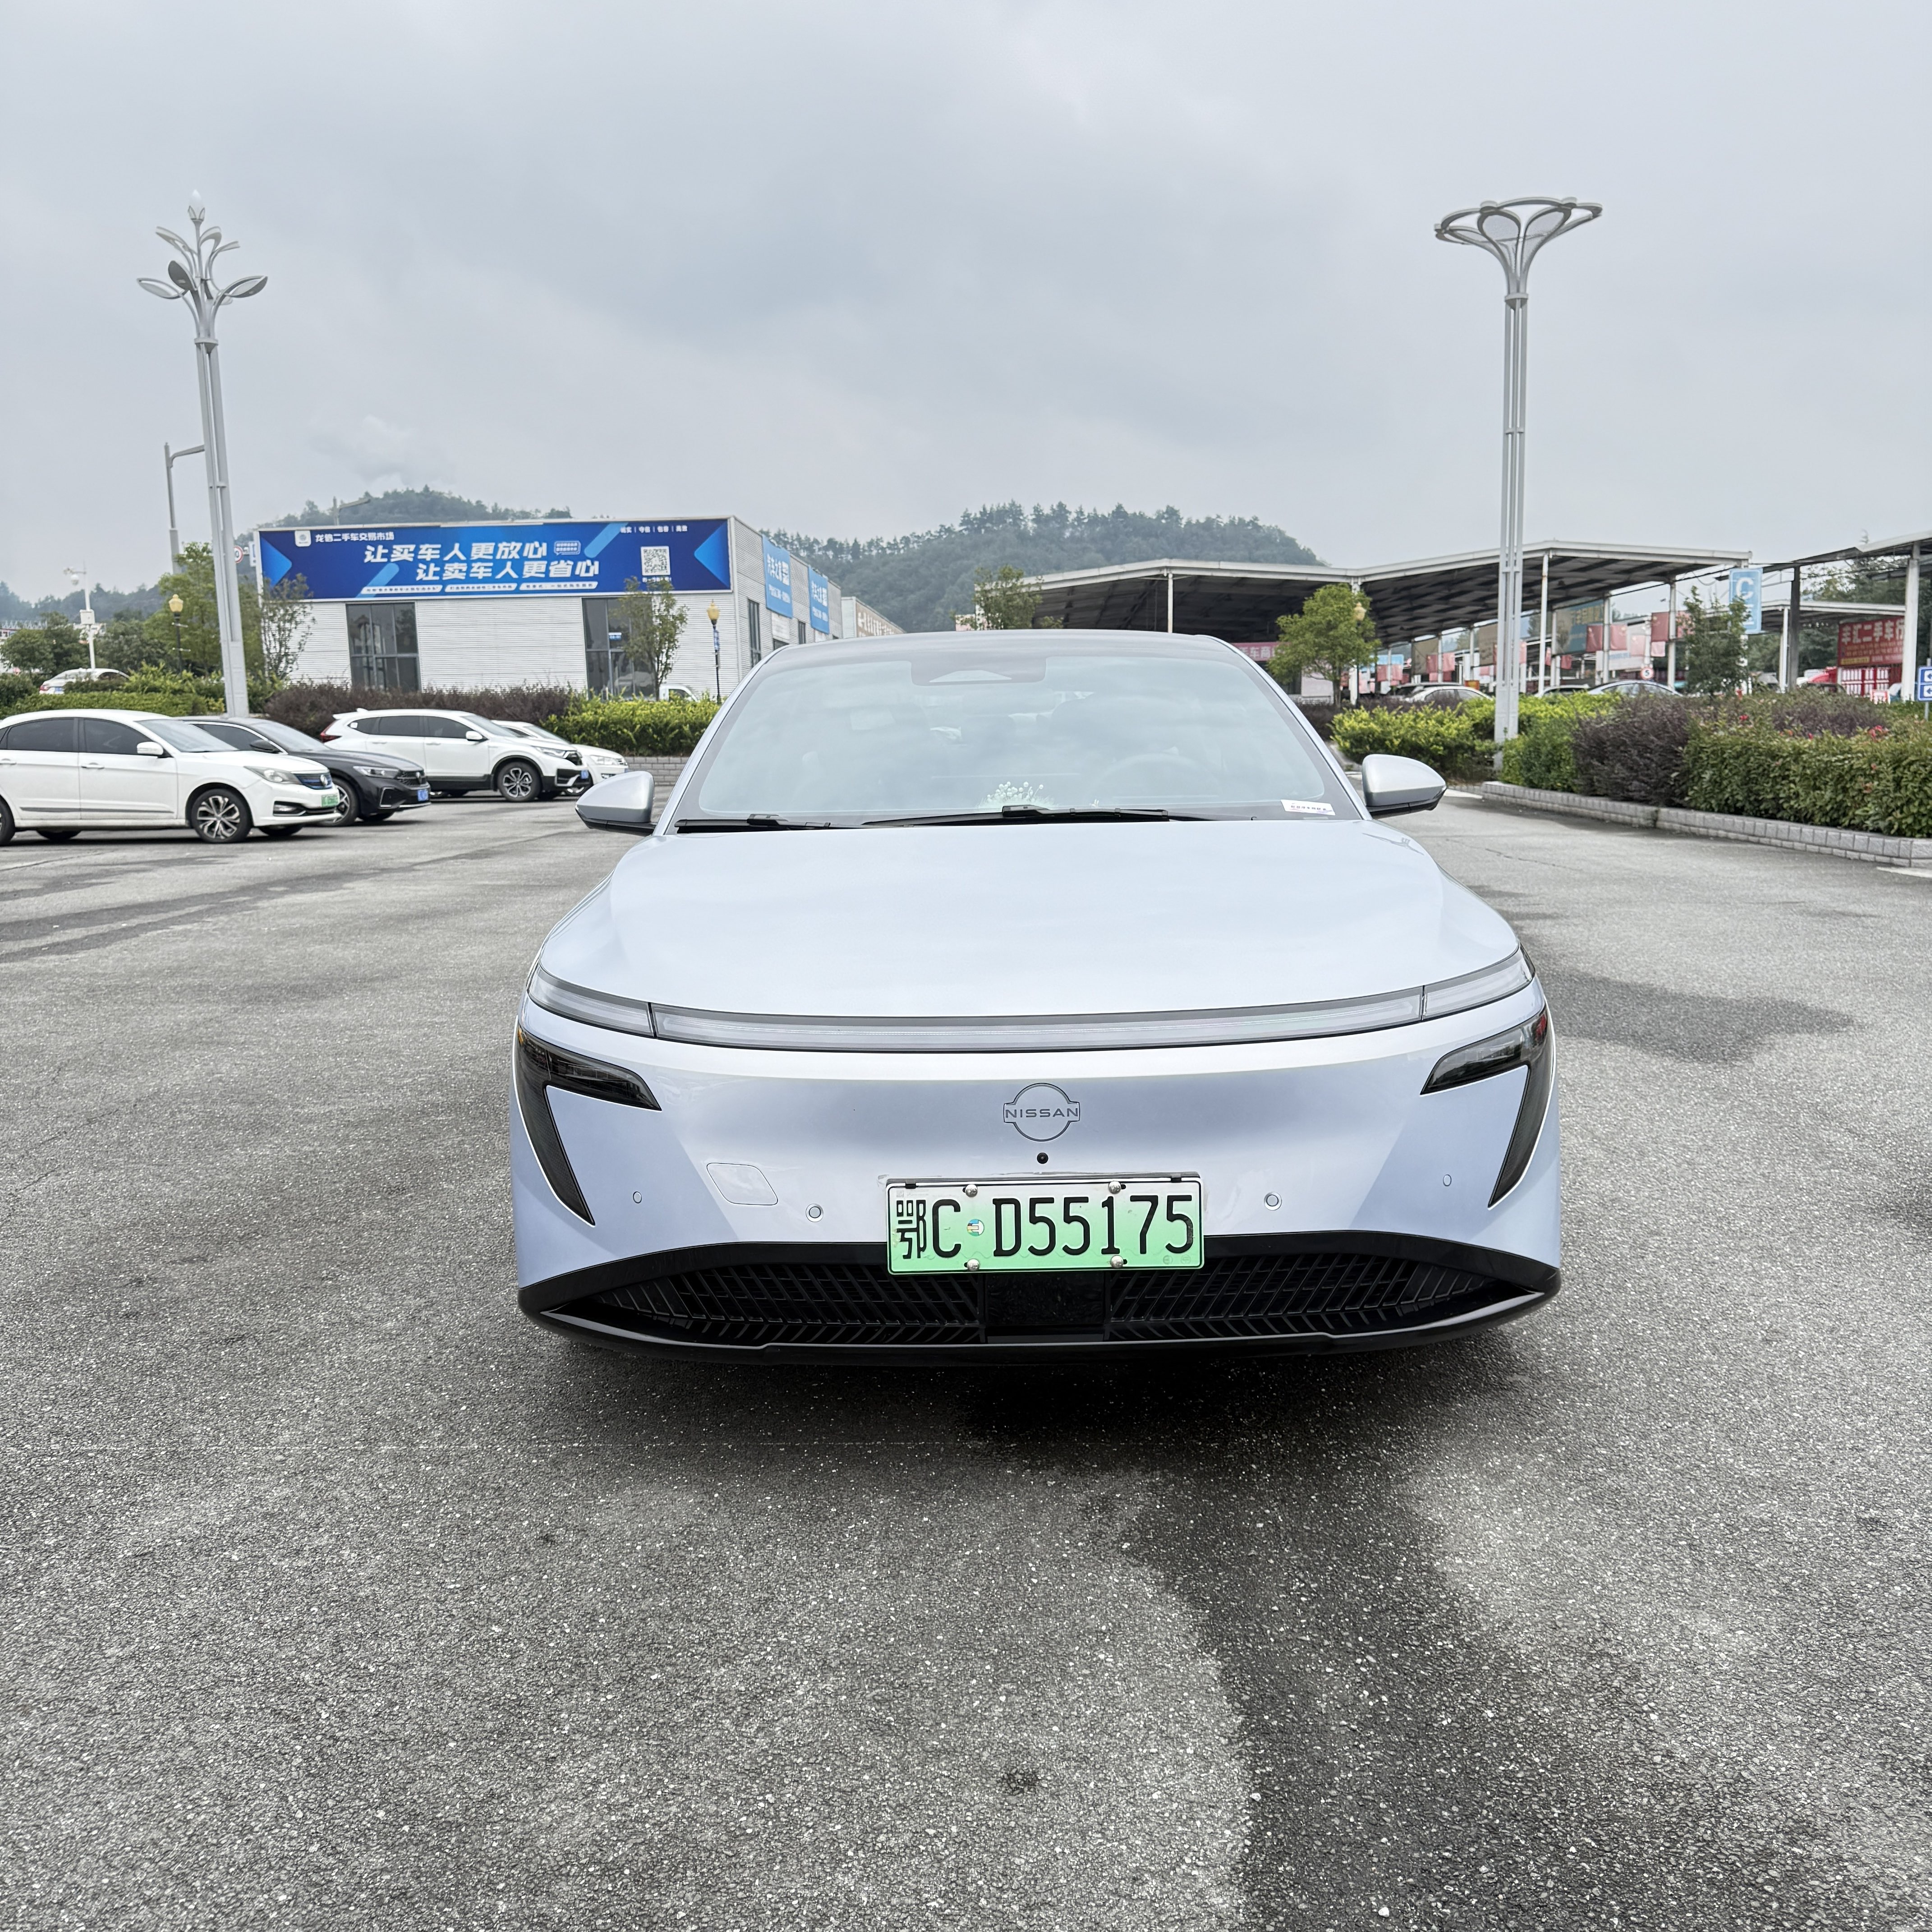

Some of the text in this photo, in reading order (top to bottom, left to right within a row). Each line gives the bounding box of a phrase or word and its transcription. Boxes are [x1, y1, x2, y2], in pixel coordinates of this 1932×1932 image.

[364, 541, 547, 563] 让买车人更放心
[416, 560, 599, 581] 让卖车人更省心
[1736, 577, 1754, 600] C
[1006, 1108, 1078, 1118] NISSAN
[897, 1195, 1194, 1259] 鄂C D55175
